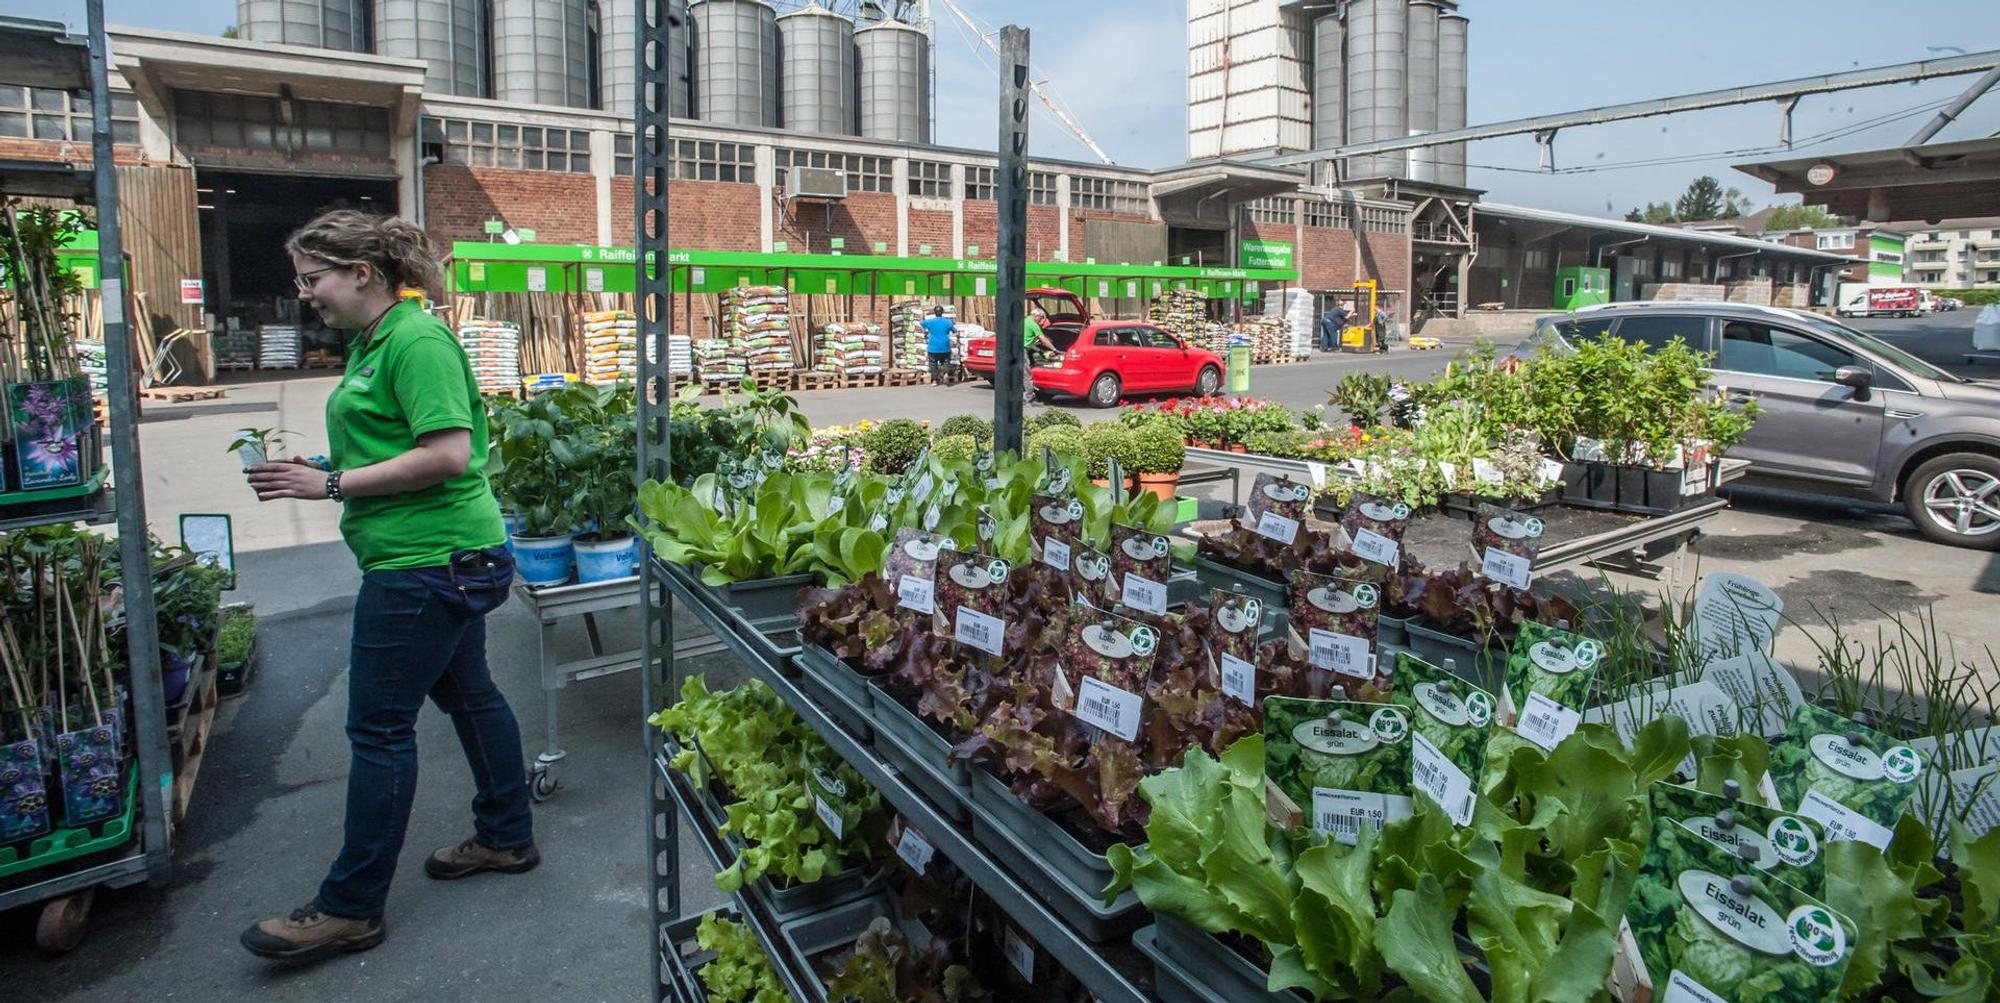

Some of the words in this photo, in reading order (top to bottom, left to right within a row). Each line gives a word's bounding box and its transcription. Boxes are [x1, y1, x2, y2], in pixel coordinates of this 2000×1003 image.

[1427, 688, 1457, 712] Eissalat
[1313, 726, 1358, 739] Eissalat
[1326, 740, 1344, 748] grün
[1828, 741, 1868, 766] Eissalat
[1350, 807, 1365, 817] EUR
[1701, 825, 1751, 847] Eissal
[1829, 819, 1843, 832] EUR
[1705, 882, 1767, 929] Eissalat
[1717, 911, 1742, 932] grün
